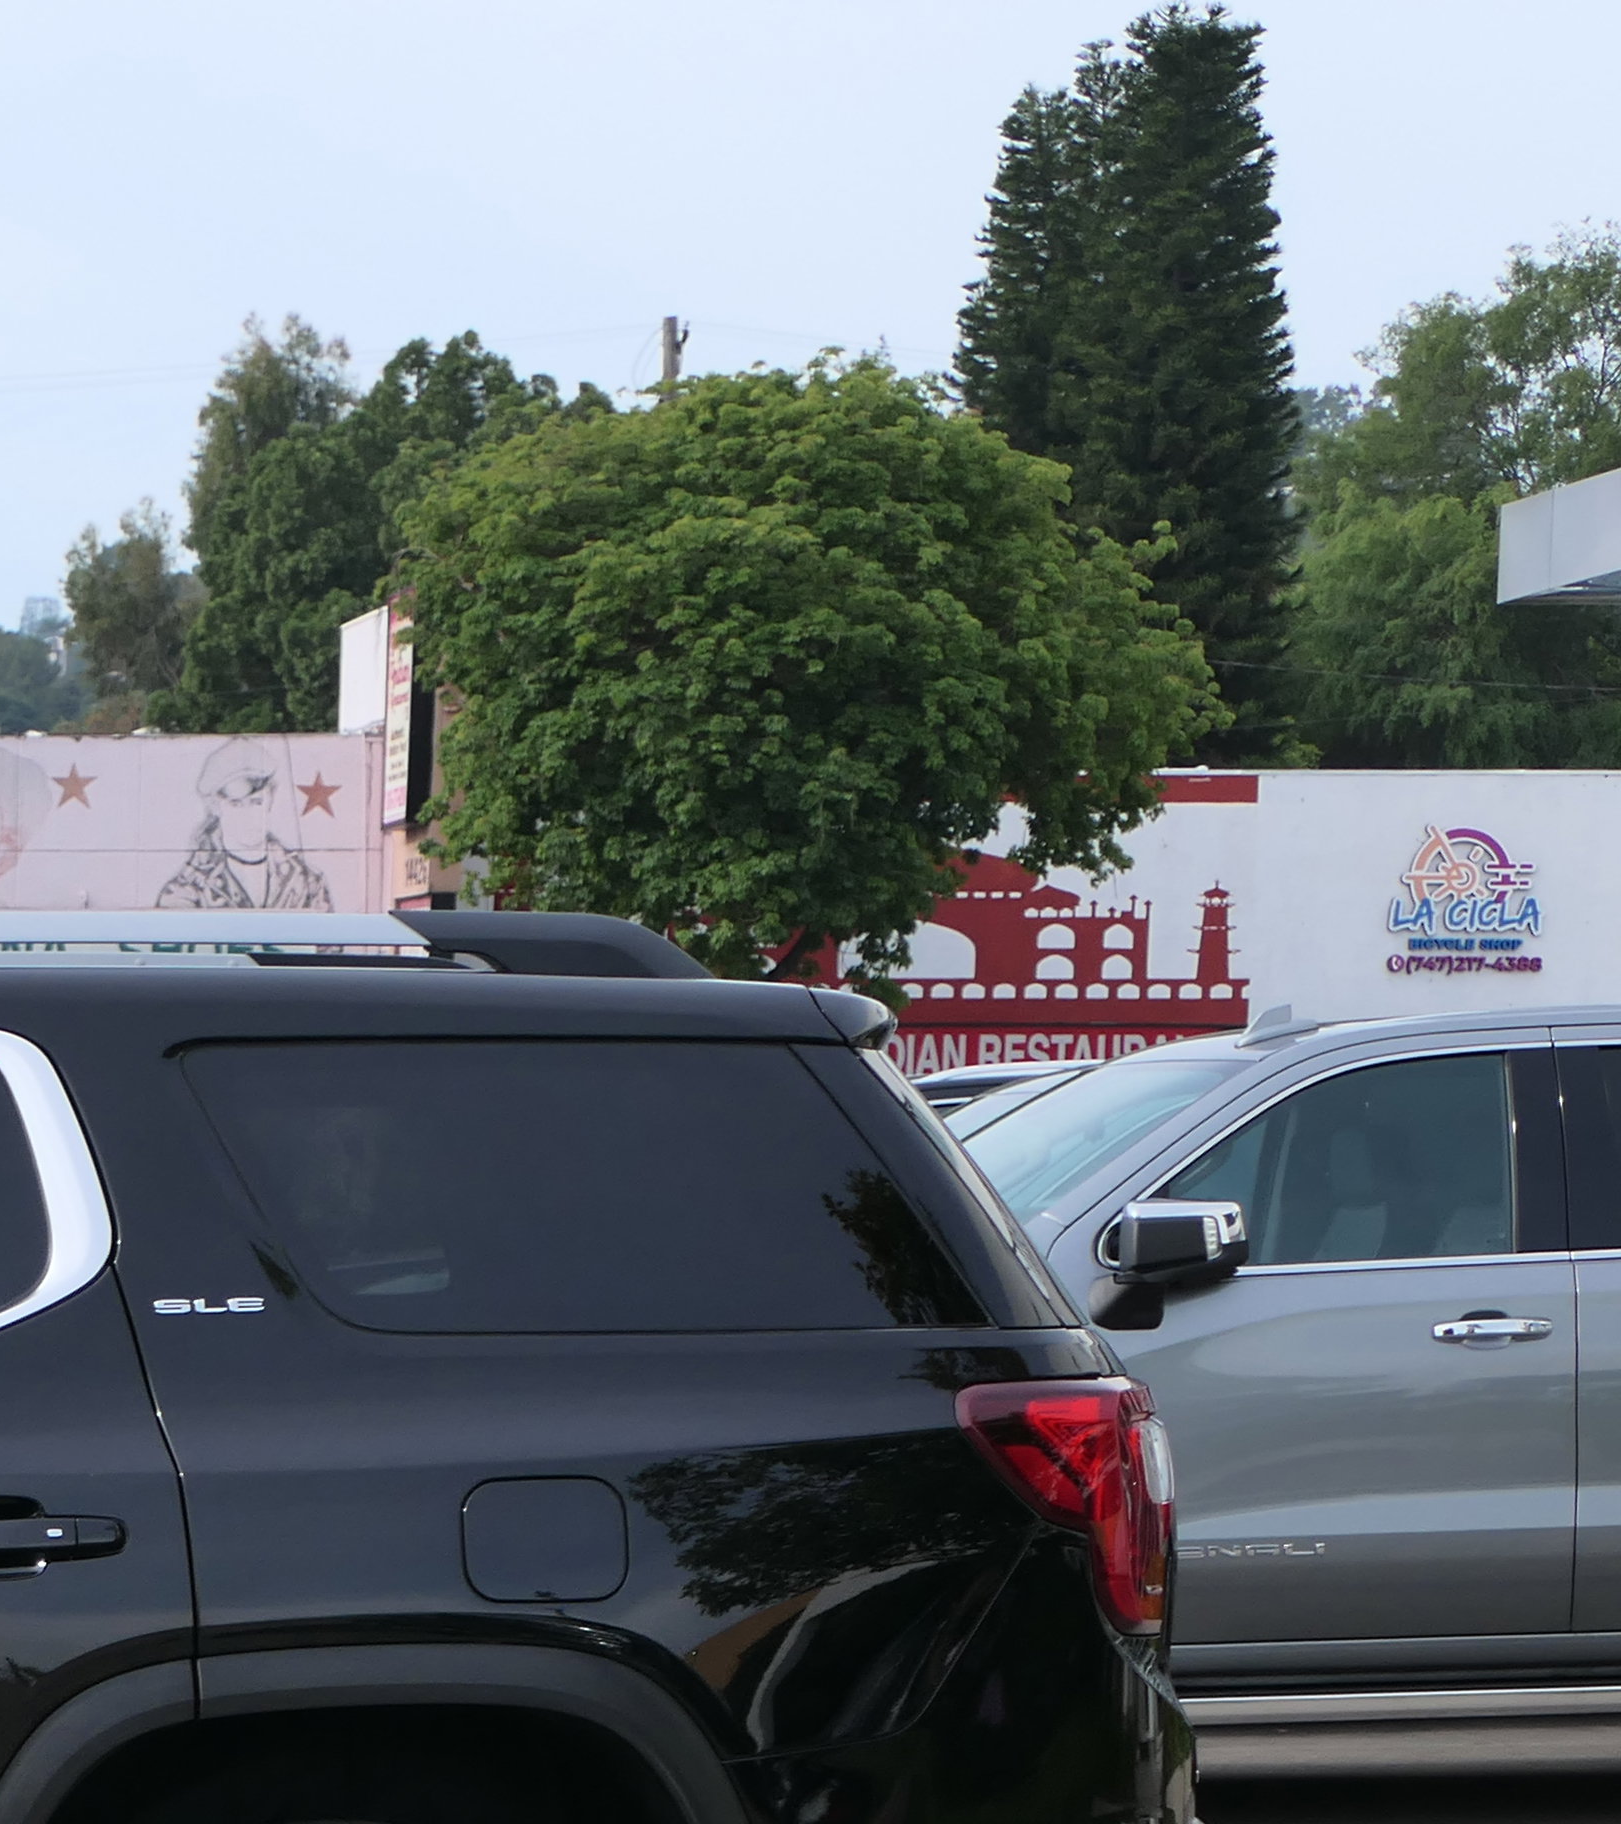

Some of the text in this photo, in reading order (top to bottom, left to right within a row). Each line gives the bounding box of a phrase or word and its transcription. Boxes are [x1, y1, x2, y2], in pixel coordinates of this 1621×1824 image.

[1389, 897, 1542, 937] LA CICLA
[1407, 938, 1524, 951] BICYCLE SHOP
[888, 1033, 1185, 1076] DIAN RESTAUR
[153, 1297, 266, 1315] SLE
[1177, 1542, 1326, 1561] ENALI
